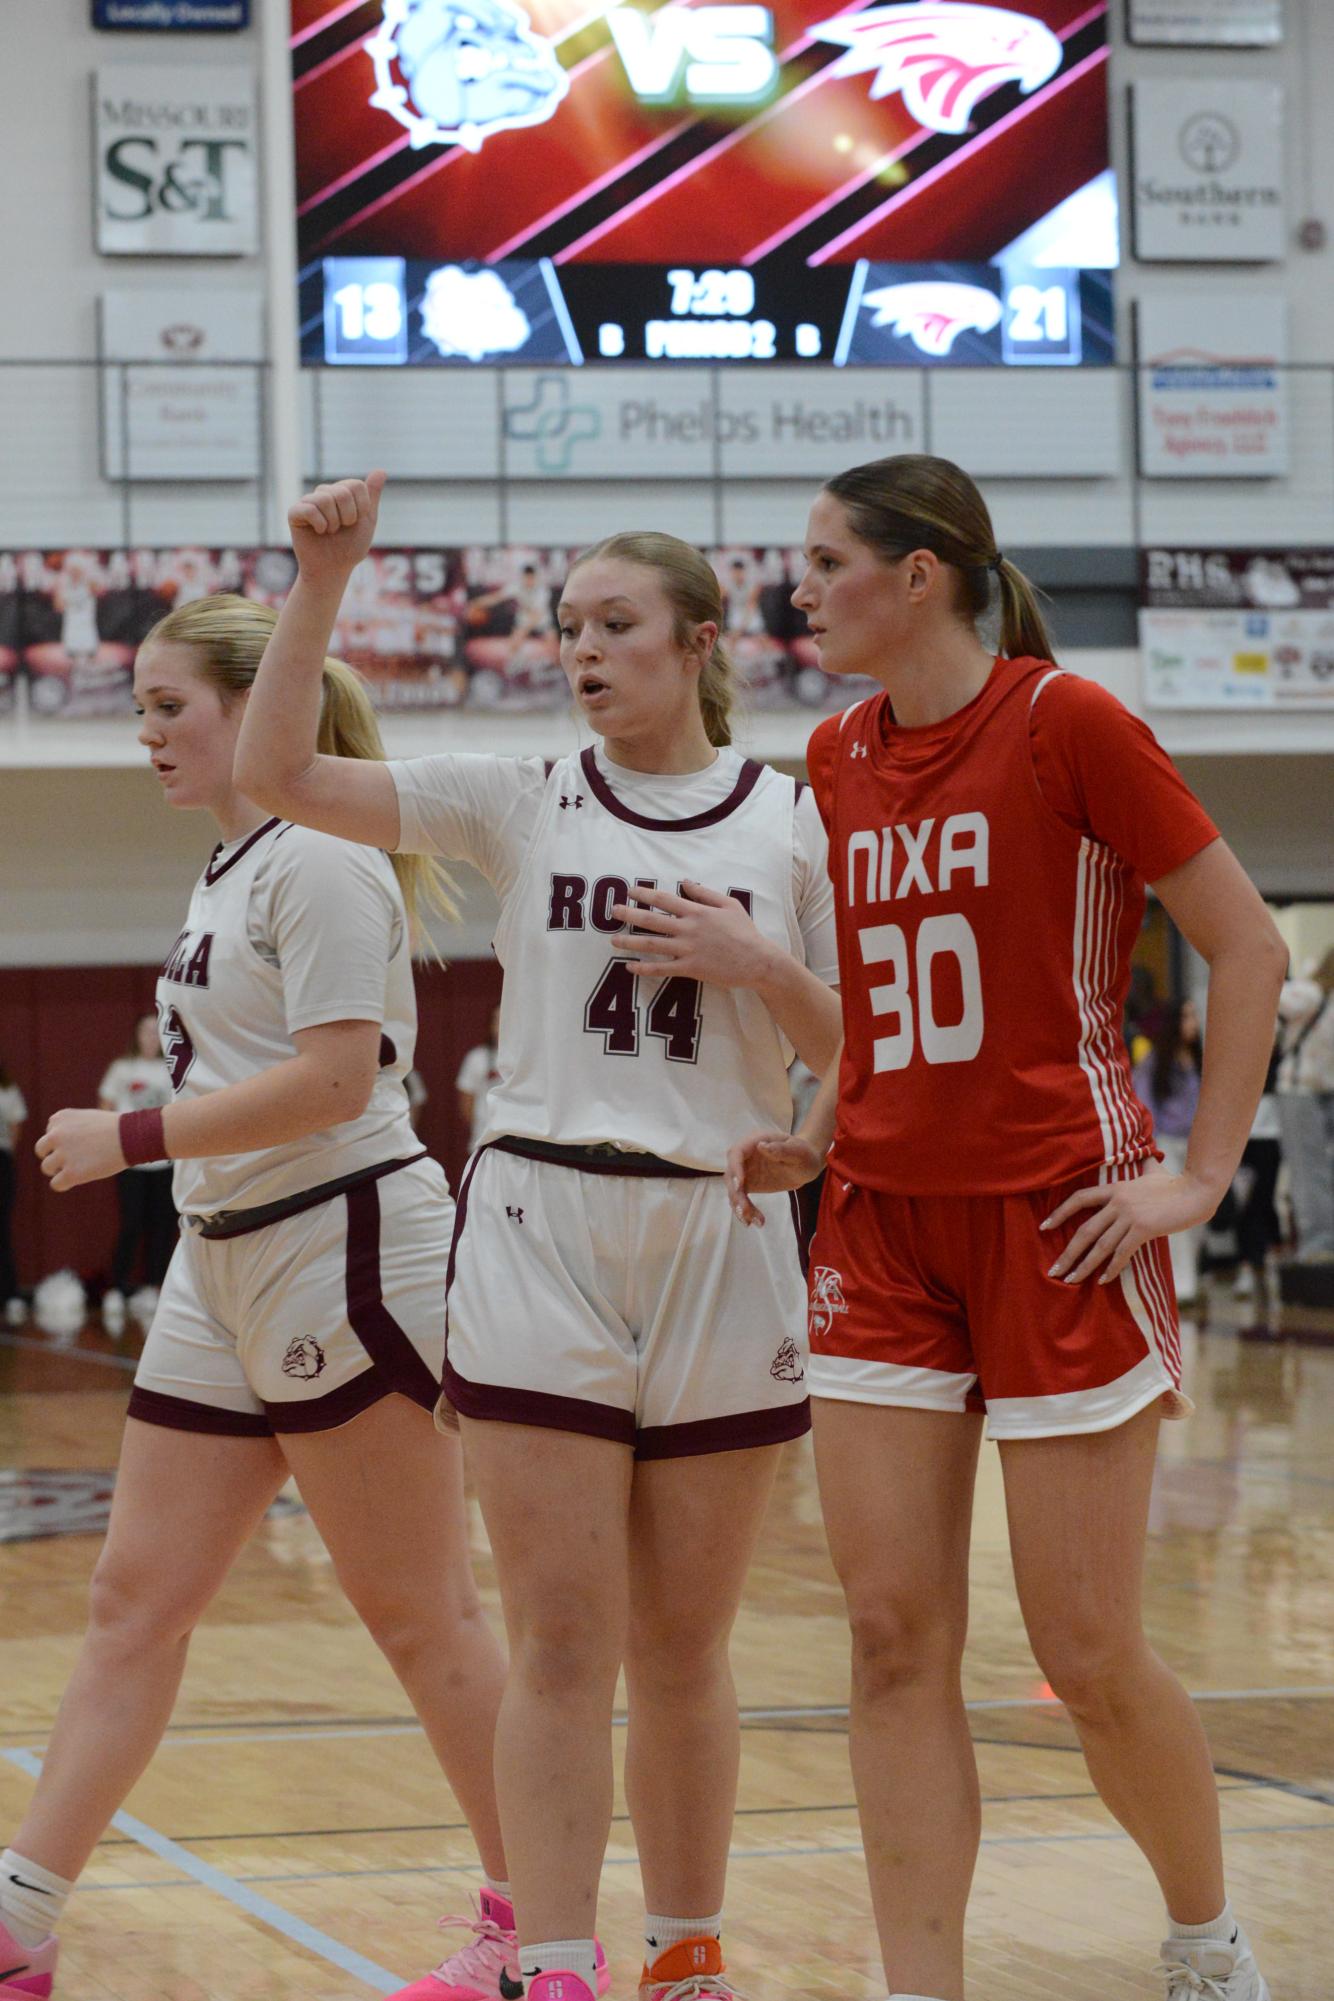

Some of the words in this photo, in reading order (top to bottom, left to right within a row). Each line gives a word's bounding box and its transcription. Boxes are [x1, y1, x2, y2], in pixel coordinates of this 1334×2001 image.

[604, 4, 776, 99] VS
[105, 136, 247, 223] S&T
[333, 282, 402, 341] 13
[1007, 285, 1067, 342] 21
[620, 401, 759, 446] Phelps
[772, 400, 913, 442] Health
[848, 811, 989, 907] NIXA
[547, 872, 754, 938] ROL
[583, 956, 703, 1065] 44
[858, 913, 985, 1074] 30
[155, 1002, 197, 1094] 3
